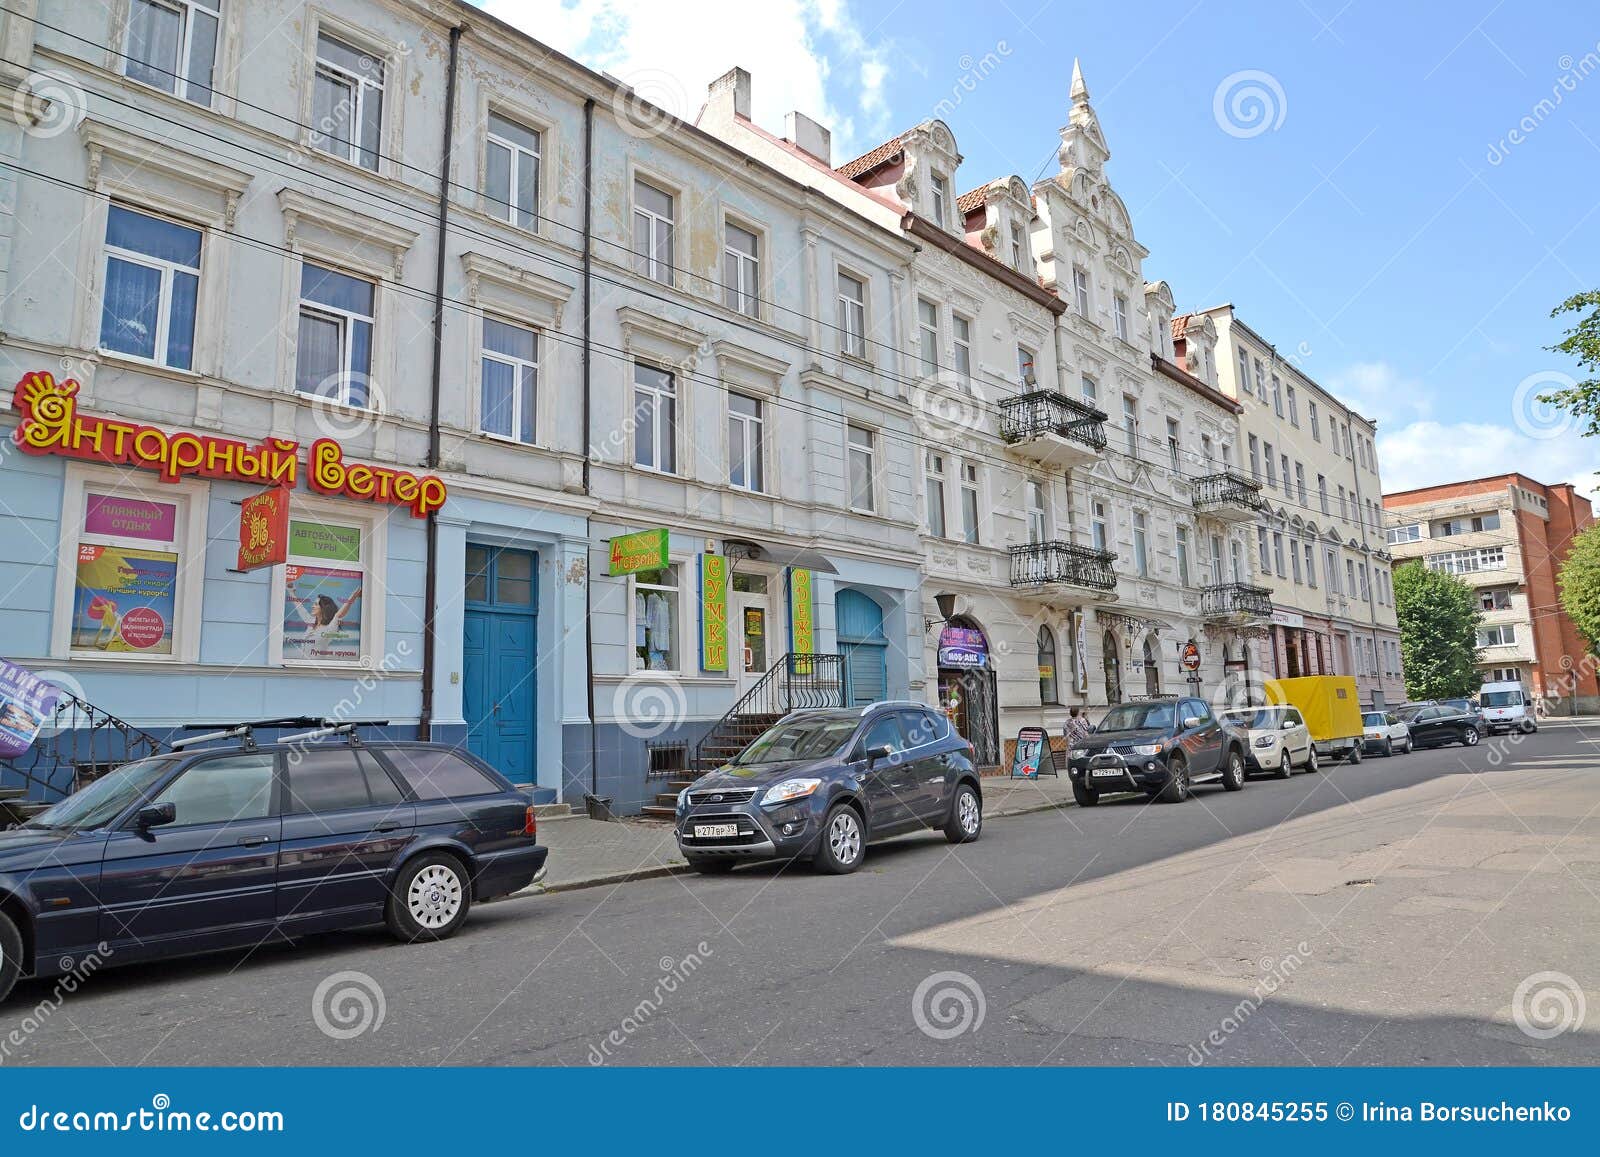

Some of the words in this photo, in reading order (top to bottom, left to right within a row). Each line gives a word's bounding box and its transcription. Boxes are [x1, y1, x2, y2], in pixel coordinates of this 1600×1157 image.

[24, 375, 296, 482] Янтарный
[315, 442, 446, 513] Ветер
[101, 504, 163, 521] ПЛЯЖНЫЙ
[112, 519, 152, 532] ОТДЫХ
[295, 529, 355, 544] АВТОБУСНЫЕ
[80, 546, 95, 555] 25
[312, 541, 337, 552] ТУРЫ
[611, 540, 623, 570] 4
[286, 566, 298, 574] 25
[706, 558, 725, 666] СУМКИ
